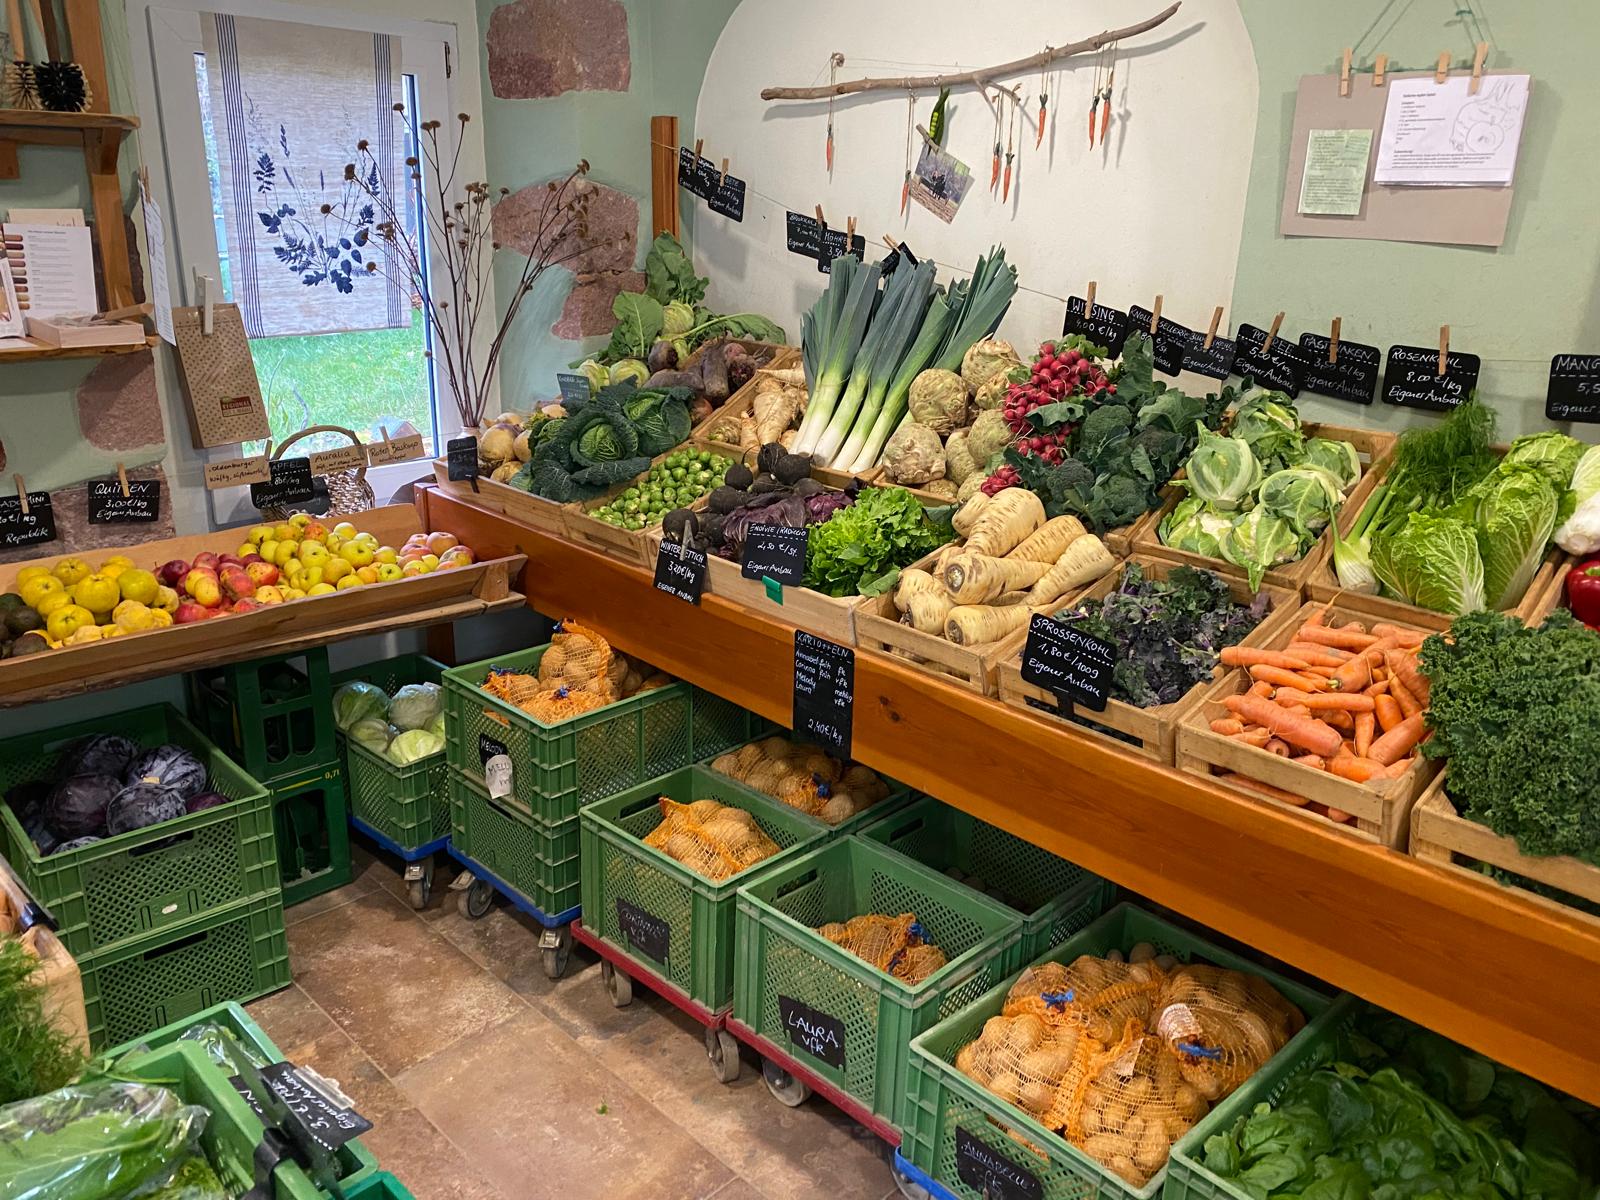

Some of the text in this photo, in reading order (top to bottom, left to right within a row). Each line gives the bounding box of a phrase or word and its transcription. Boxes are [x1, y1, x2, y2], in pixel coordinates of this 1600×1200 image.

[824, 232, 849, 245] MÖHRE
[1072, 298, 1116, 322] WISING
[1131, 308, 1189, 339] KNOLLSELLERIE
[1252, 329, 1294, 353] POREE
[1302, 334, 1374, 359] PASTAKEN
[1392, 347, 1462, 369] ROSENKHL
[1263, 369, 1293, 390] Anbau
[1388, 385, 1425, 402] Eigener
[314, 450, 350, 463] Auralia
[95, 482, 150, 495] QUITEN
[5, 527, 48, 545] Republik
[660, 540, 705, 563] WINTERETTICH
[1032, 618, 1113, 661] SPROSSENKOHL
[795, 659, 816, 674] Corinna
[795, 681, 812, 695] Laura
[796, 670, 816, 690] Melody
[1028, 657, 1101, 698] Eigener Anbau
[788, 1010, 839, 1049] LAURA
